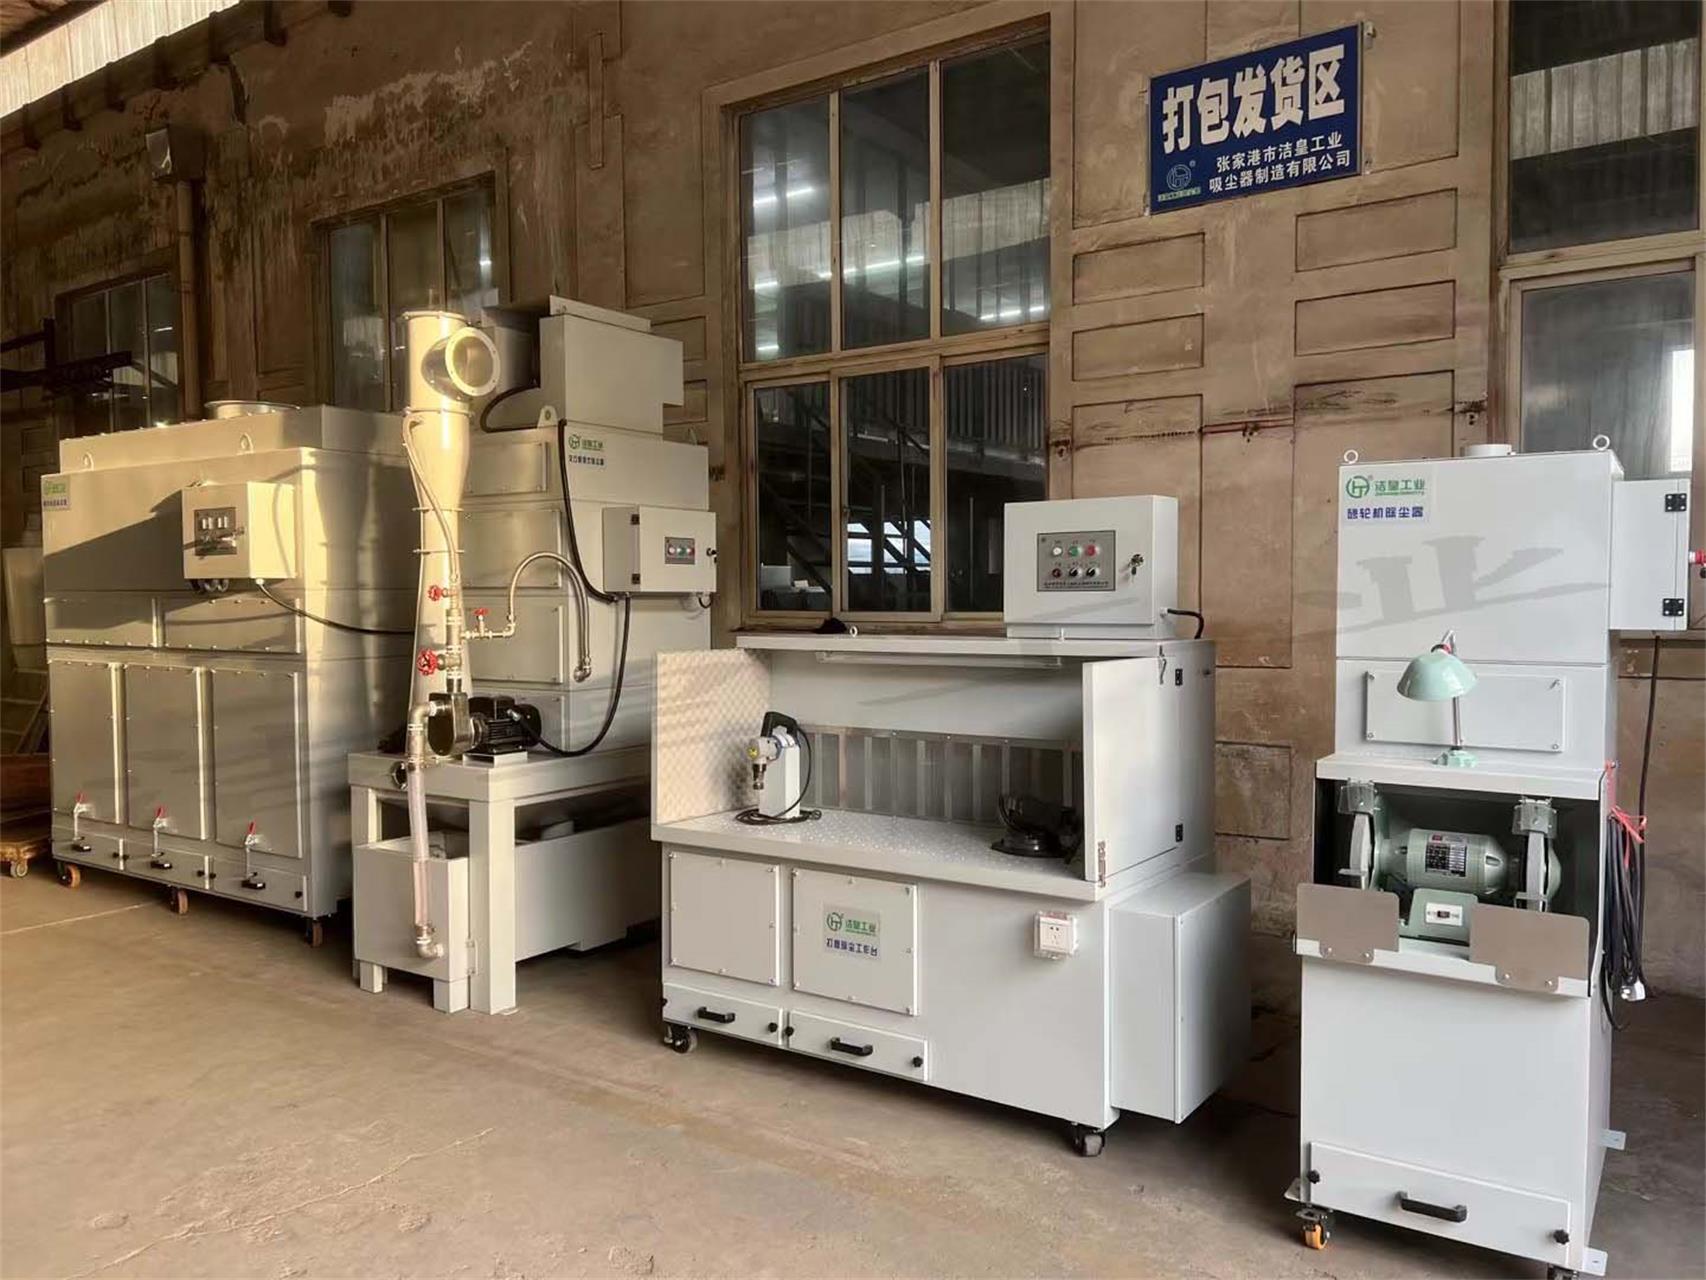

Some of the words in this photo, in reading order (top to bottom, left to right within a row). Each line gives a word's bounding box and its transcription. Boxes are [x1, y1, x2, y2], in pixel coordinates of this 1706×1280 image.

[1162, 44, 1345, 154] 打包发货区
[1208, 150, 1350, 193] 吸尘器制造有限公司
[1216, 131, 1343, 173] 张家港市洁皇工业
